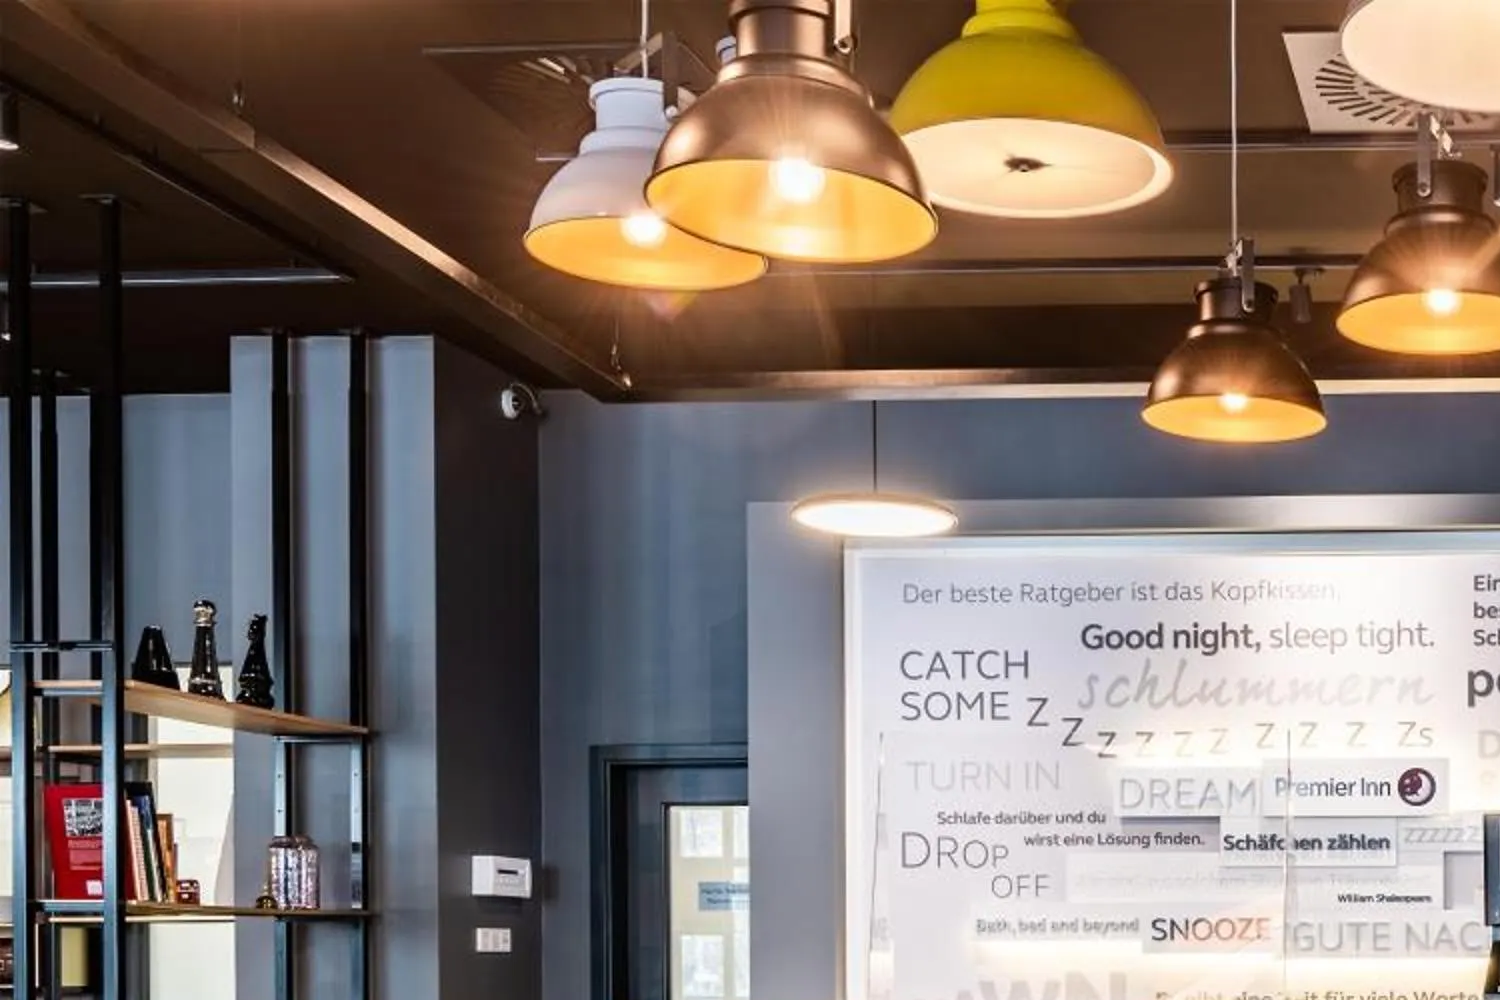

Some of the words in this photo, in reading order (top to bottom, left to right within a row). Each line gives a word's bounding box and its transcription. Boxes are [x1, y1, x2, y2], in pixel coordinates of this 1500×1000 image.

[903, 583, 942, 604] Der
[951, 581, 1013, 603] beste
[1020, 581, 1123, 607] Ratgeber
[1131, 581, 1158, 601] ist
[1165, 581, 1203, 602] das
[1081, 622, 1164, 649] Good
[1173, 621, 1261, 655] night,
[1269, 621, 1347, 653] sleep
[1357, 620, 1435, 654] tight.
[900, 650, 1029, 680] CATCH
[1078, 658, 1433, 710] schlummern
[901, 691, 1010, 721] SOME
[906, 760, 1010, 791] TURN
[1025, 760, 1060, 791] IN
[1275, 777, 1355, 797] Premier
[1361, 777, 1391, 797] Inn
[1120, 777, 1256, 811] DREAM
[937, 811, 991, 825] Schlafe
[995, 810, 1051, 825] darüber
[1055, 811, 1083, 824] und
[1087, 811, 1106, 824] du
[901, 832, 1009, 868] DROP
[1024, 833, 1060, 847] wirst
[1064, 833, 1094, 847] eine
[1098, 832, 1150, 849] Lösung
[1154, 832, 1206, 847] finden.
[1327, 834, 1390, 851] zählen
[991, 874, 1050, 898] OFF
[1050, 918, 1078, 933] and
[1082, 918, 1139, 937] beyond
[1151, 918, 1271, 942] SNOOZE
[1293, 921, 1390, 951] GUTE
[1405, 921, 1482, 952] NAC
